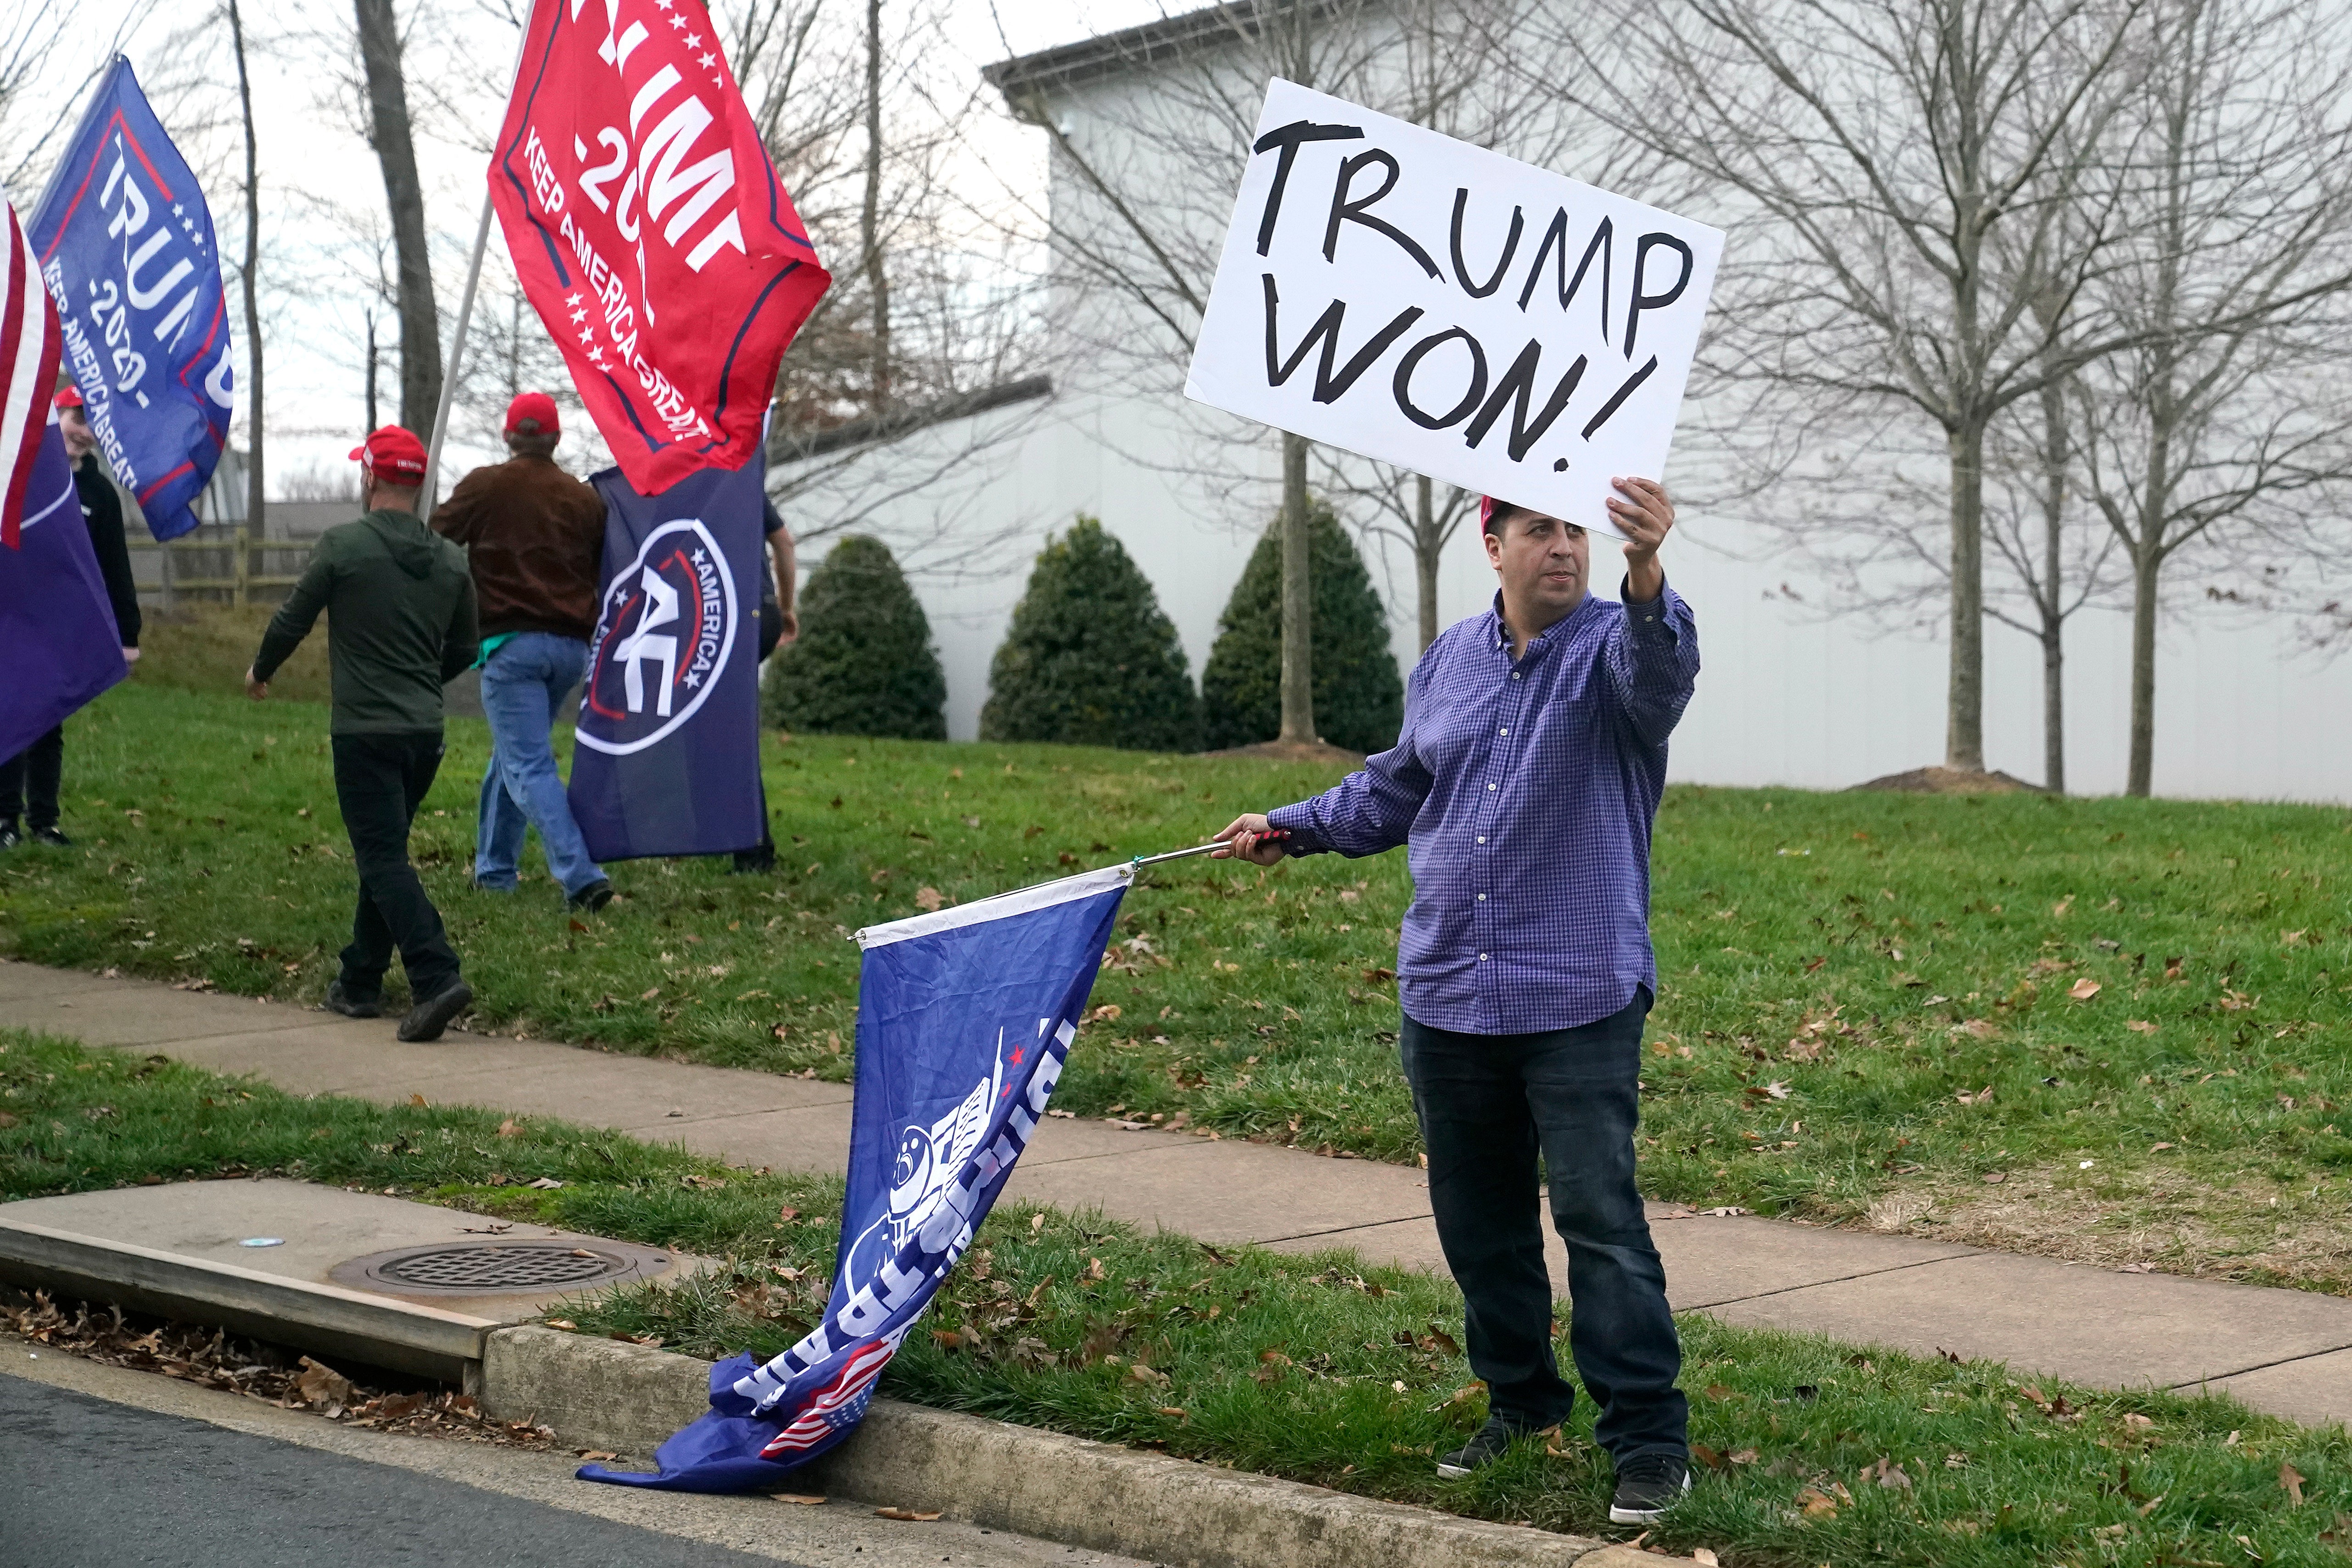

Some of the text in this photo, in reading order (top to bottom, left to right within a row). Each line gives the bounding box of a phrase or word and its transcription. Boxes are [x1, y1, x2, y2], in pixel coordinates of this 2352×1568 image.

[43, 255, 68, 317] KEEP
[61, 317, 111, 423] AMERICA
[524, 125, 564, 214] KEEP
[560, 212, 638, 367] AMERICA
[1253, 119, 1693, 362] TRUMP
[1262, 273, 1657, 472] WON!
[691, 564, 721, 671] AMERICA
